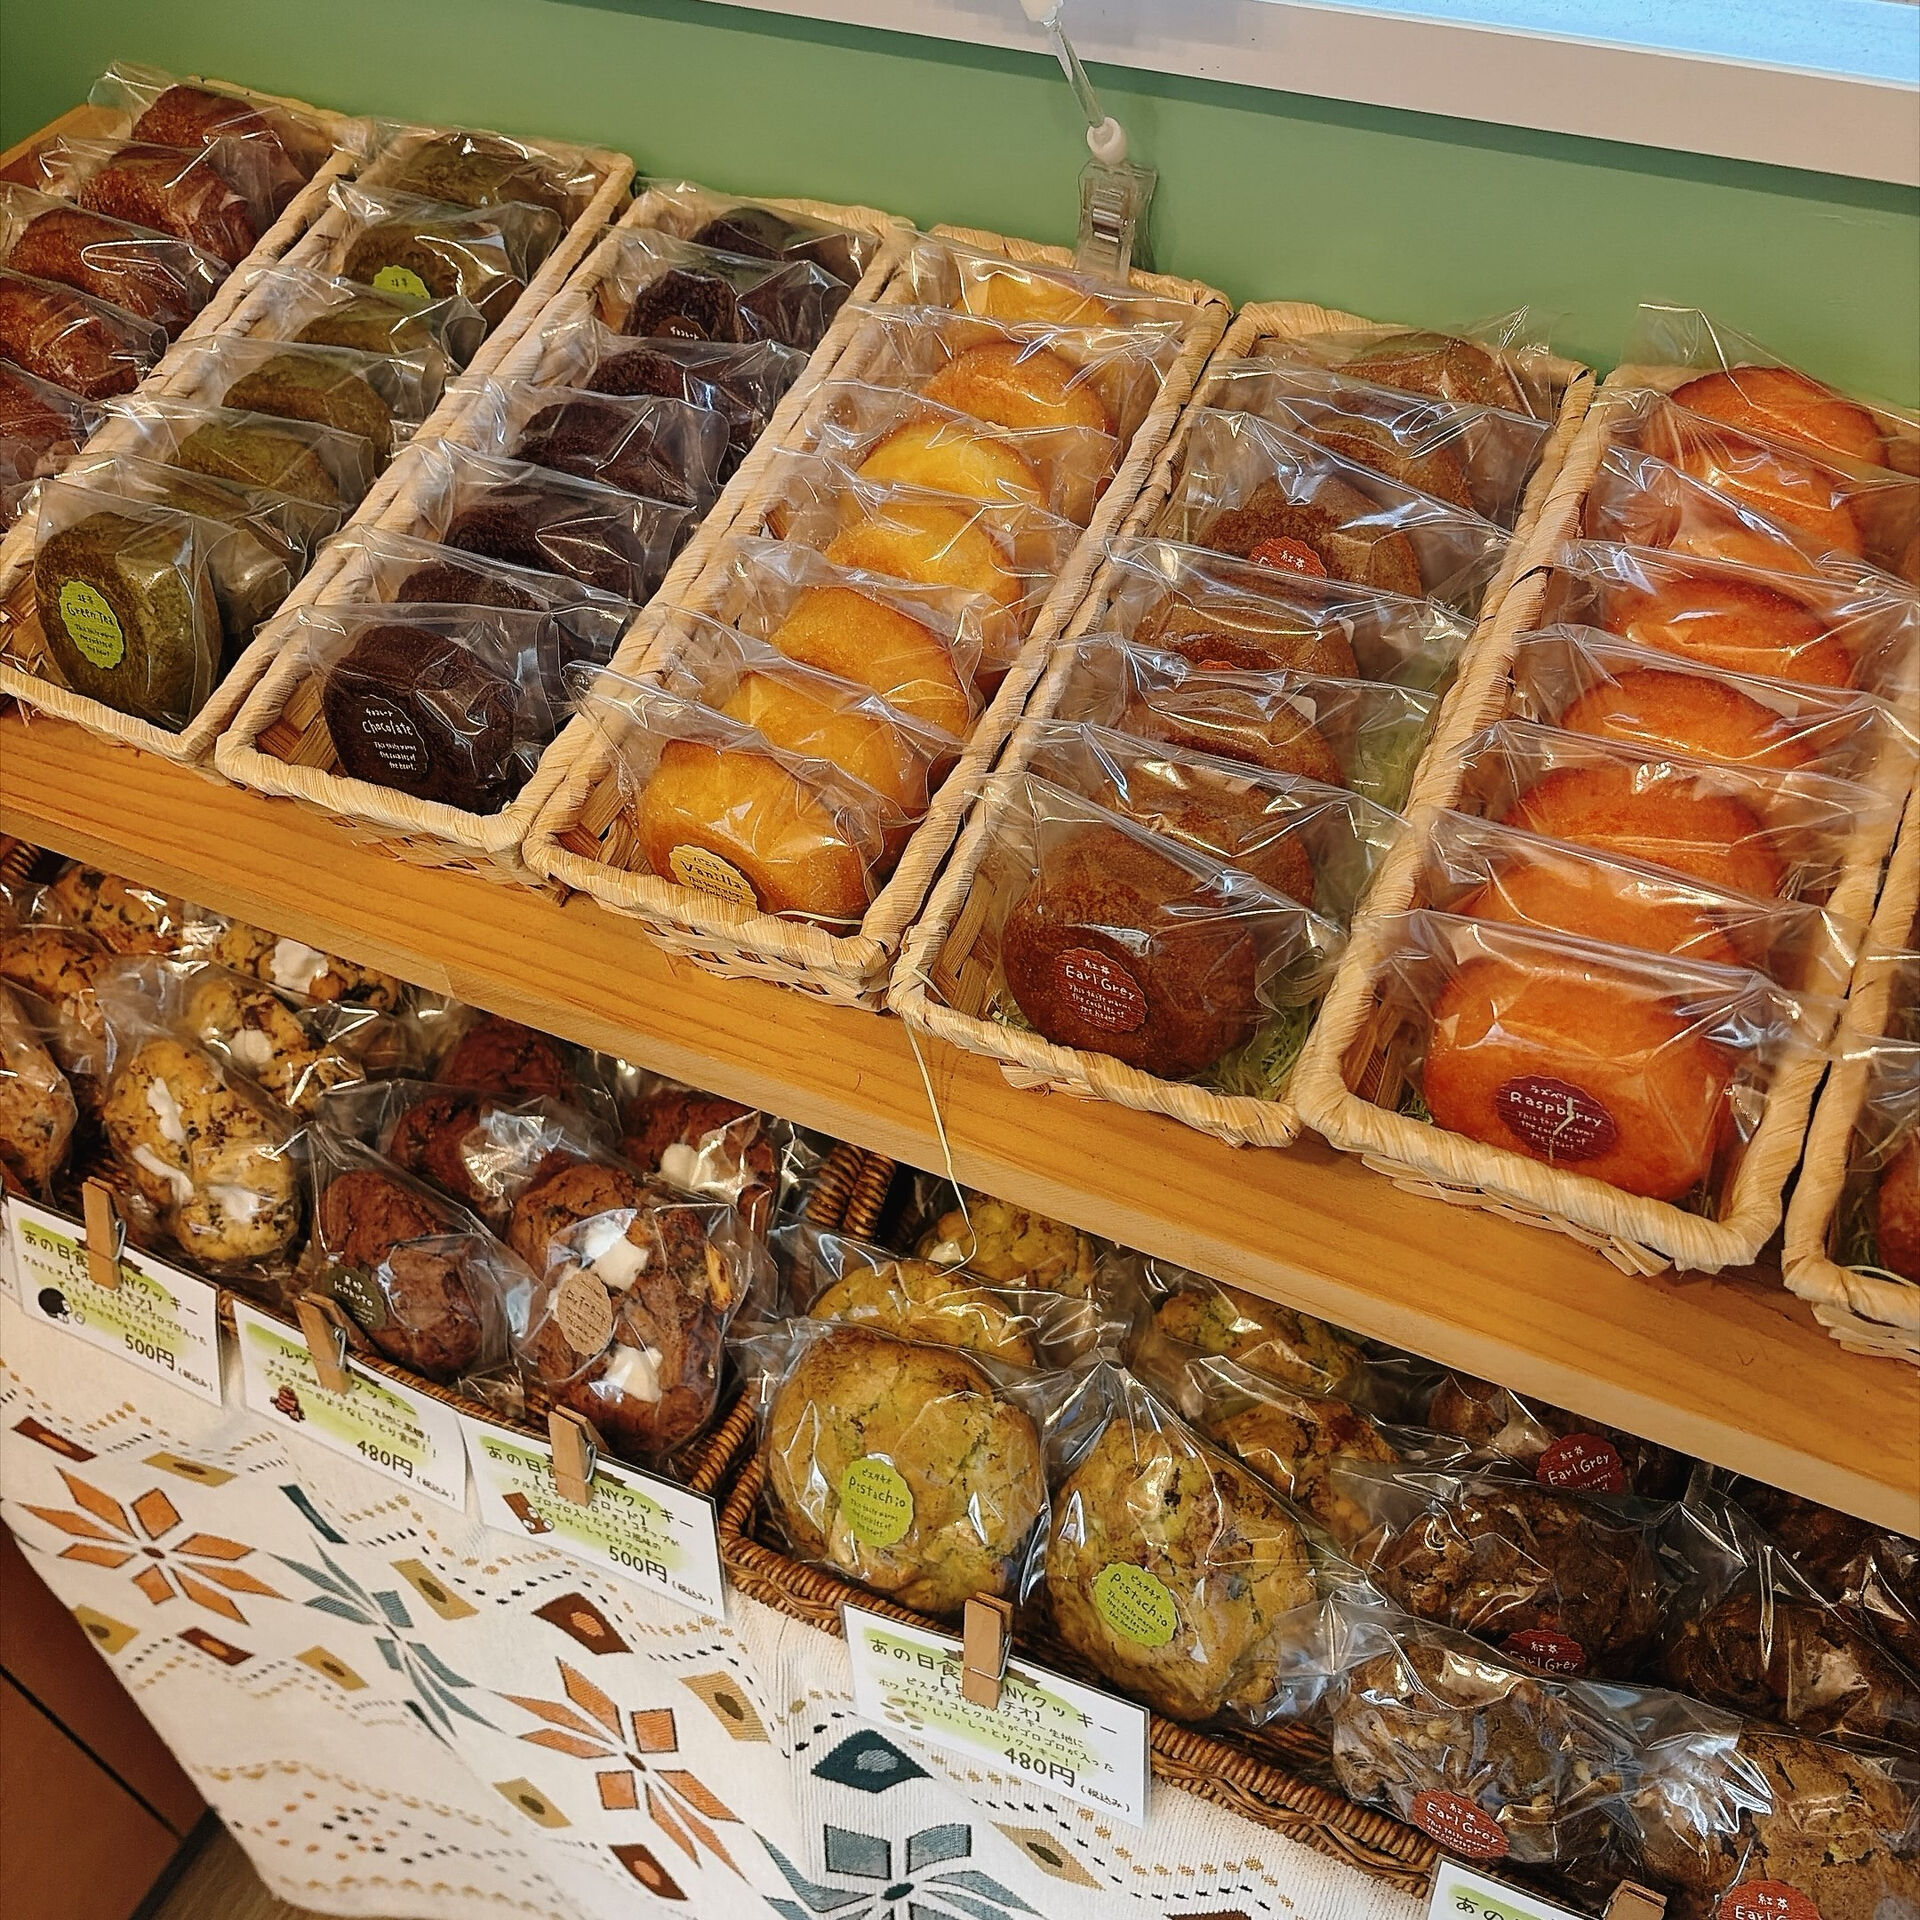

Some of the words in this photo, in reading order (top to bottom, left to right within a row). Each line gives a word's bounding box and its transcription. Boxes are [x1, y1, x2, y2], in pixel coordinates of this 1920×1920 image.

[66, 602, 97, 620] Green
[96, 610, 114, 626] Tea
[362, 719, 413, 736] Chocolate
[681, 860, 742, 890] Vanilla
[1065, 965, 1098, 985] Earl
[1101, 978, 1136, 1001] Grey
[1510, 1091, 1602, 1127] Raspbrry
[1538, 1126, 1573, 1142] cocles
[125, 1333, 175, 1371] 500円
[357, 1440, 413, 1479] 480円
[1548, 1463, 1579, 1486] Earl
[1580, 1455, 1609, 1473] Grey
[848, 1475, 906, 1507] Pistachio
[609, 1545, 667, 1584] 500円
[1110, 1573, 1168, 1627] Pistachio
[1131, 1575, 1162, 1601] ピスタチオ
[1530, 1641, 1558, 1654] 紅茶
[1545, 1658, 1578, 1674] Grey
[870, 1638, 1118, 1735] あの日食NYクッキー
[1004, 1747, 1076, 1788] 480円
[1426, 1801, 1459, 1826] Earl
[1462, 1821, 1499, 1845] Grey
[1758, 1892, 1789, 1910] 紅茶
